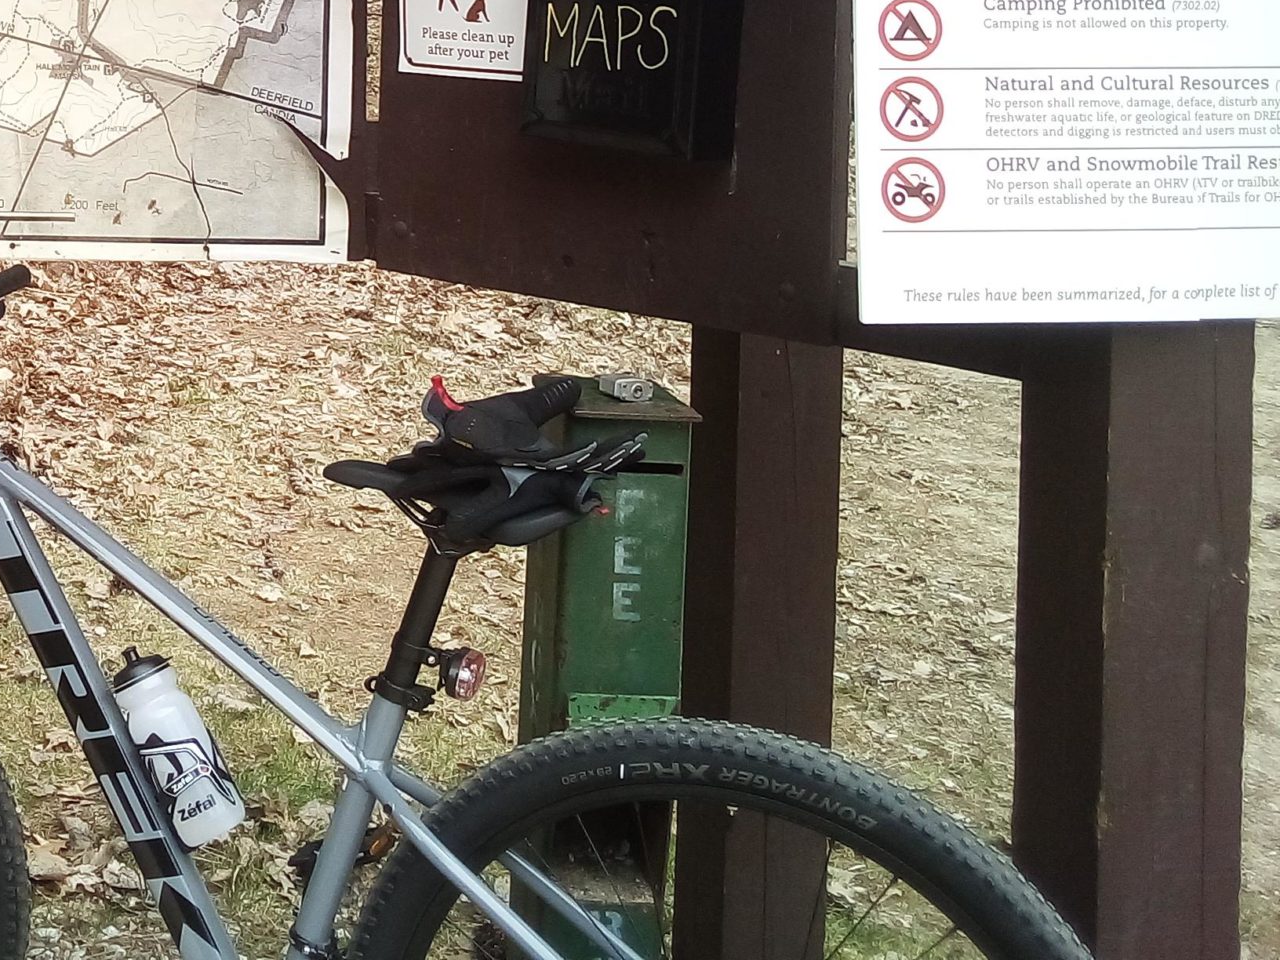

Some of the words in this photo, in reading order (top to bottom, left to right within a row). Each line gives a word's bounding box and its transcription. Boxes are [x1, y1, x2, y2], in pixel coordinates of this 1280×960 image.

[1172, 0, 1220, 12] (7302.02)
[984, 18, 1039, 31] Camping
[1043, 18, 1052, 28] is
[1056, 19, 1076, 28] not
[1080, 17, 1127, 28] allowed
[1131, 20, 1146, 28] on
[1150, 17, 1172, 28] this
[1176, 19, 1228, 31] property.
[422, 27, 458, 41] Please
[461, 29, 494, 44] clean
[498, 31, 515, 47] up
[544, 2, 678, 72] MAPS
[427, 43, 454, 58] after
[456, 46, 486, 61] your
[489, 47, 510, 62] pet
[985, 75, 1054, 91] Natural
[1061, 75, 1094, 90] and
[1101, 75, 1174, 90] Cultural
[1180, 76, 1269, 90] Resources
[251, 87, 313, 112] DEERFIELD
[253, 104, 297, 124] CANDIA
[987, 157, 1040, 171] OHRV
[1047, 156, 1080, 171] and
[1088, 155, 1197, 171] Snowmobile
[1202, 154, 1241, 170] Trail
[95, 200, 119, 211] Feet
[613, 489, 644, 622] FEE
[718, 765, 879, 831] BONTRAGER
